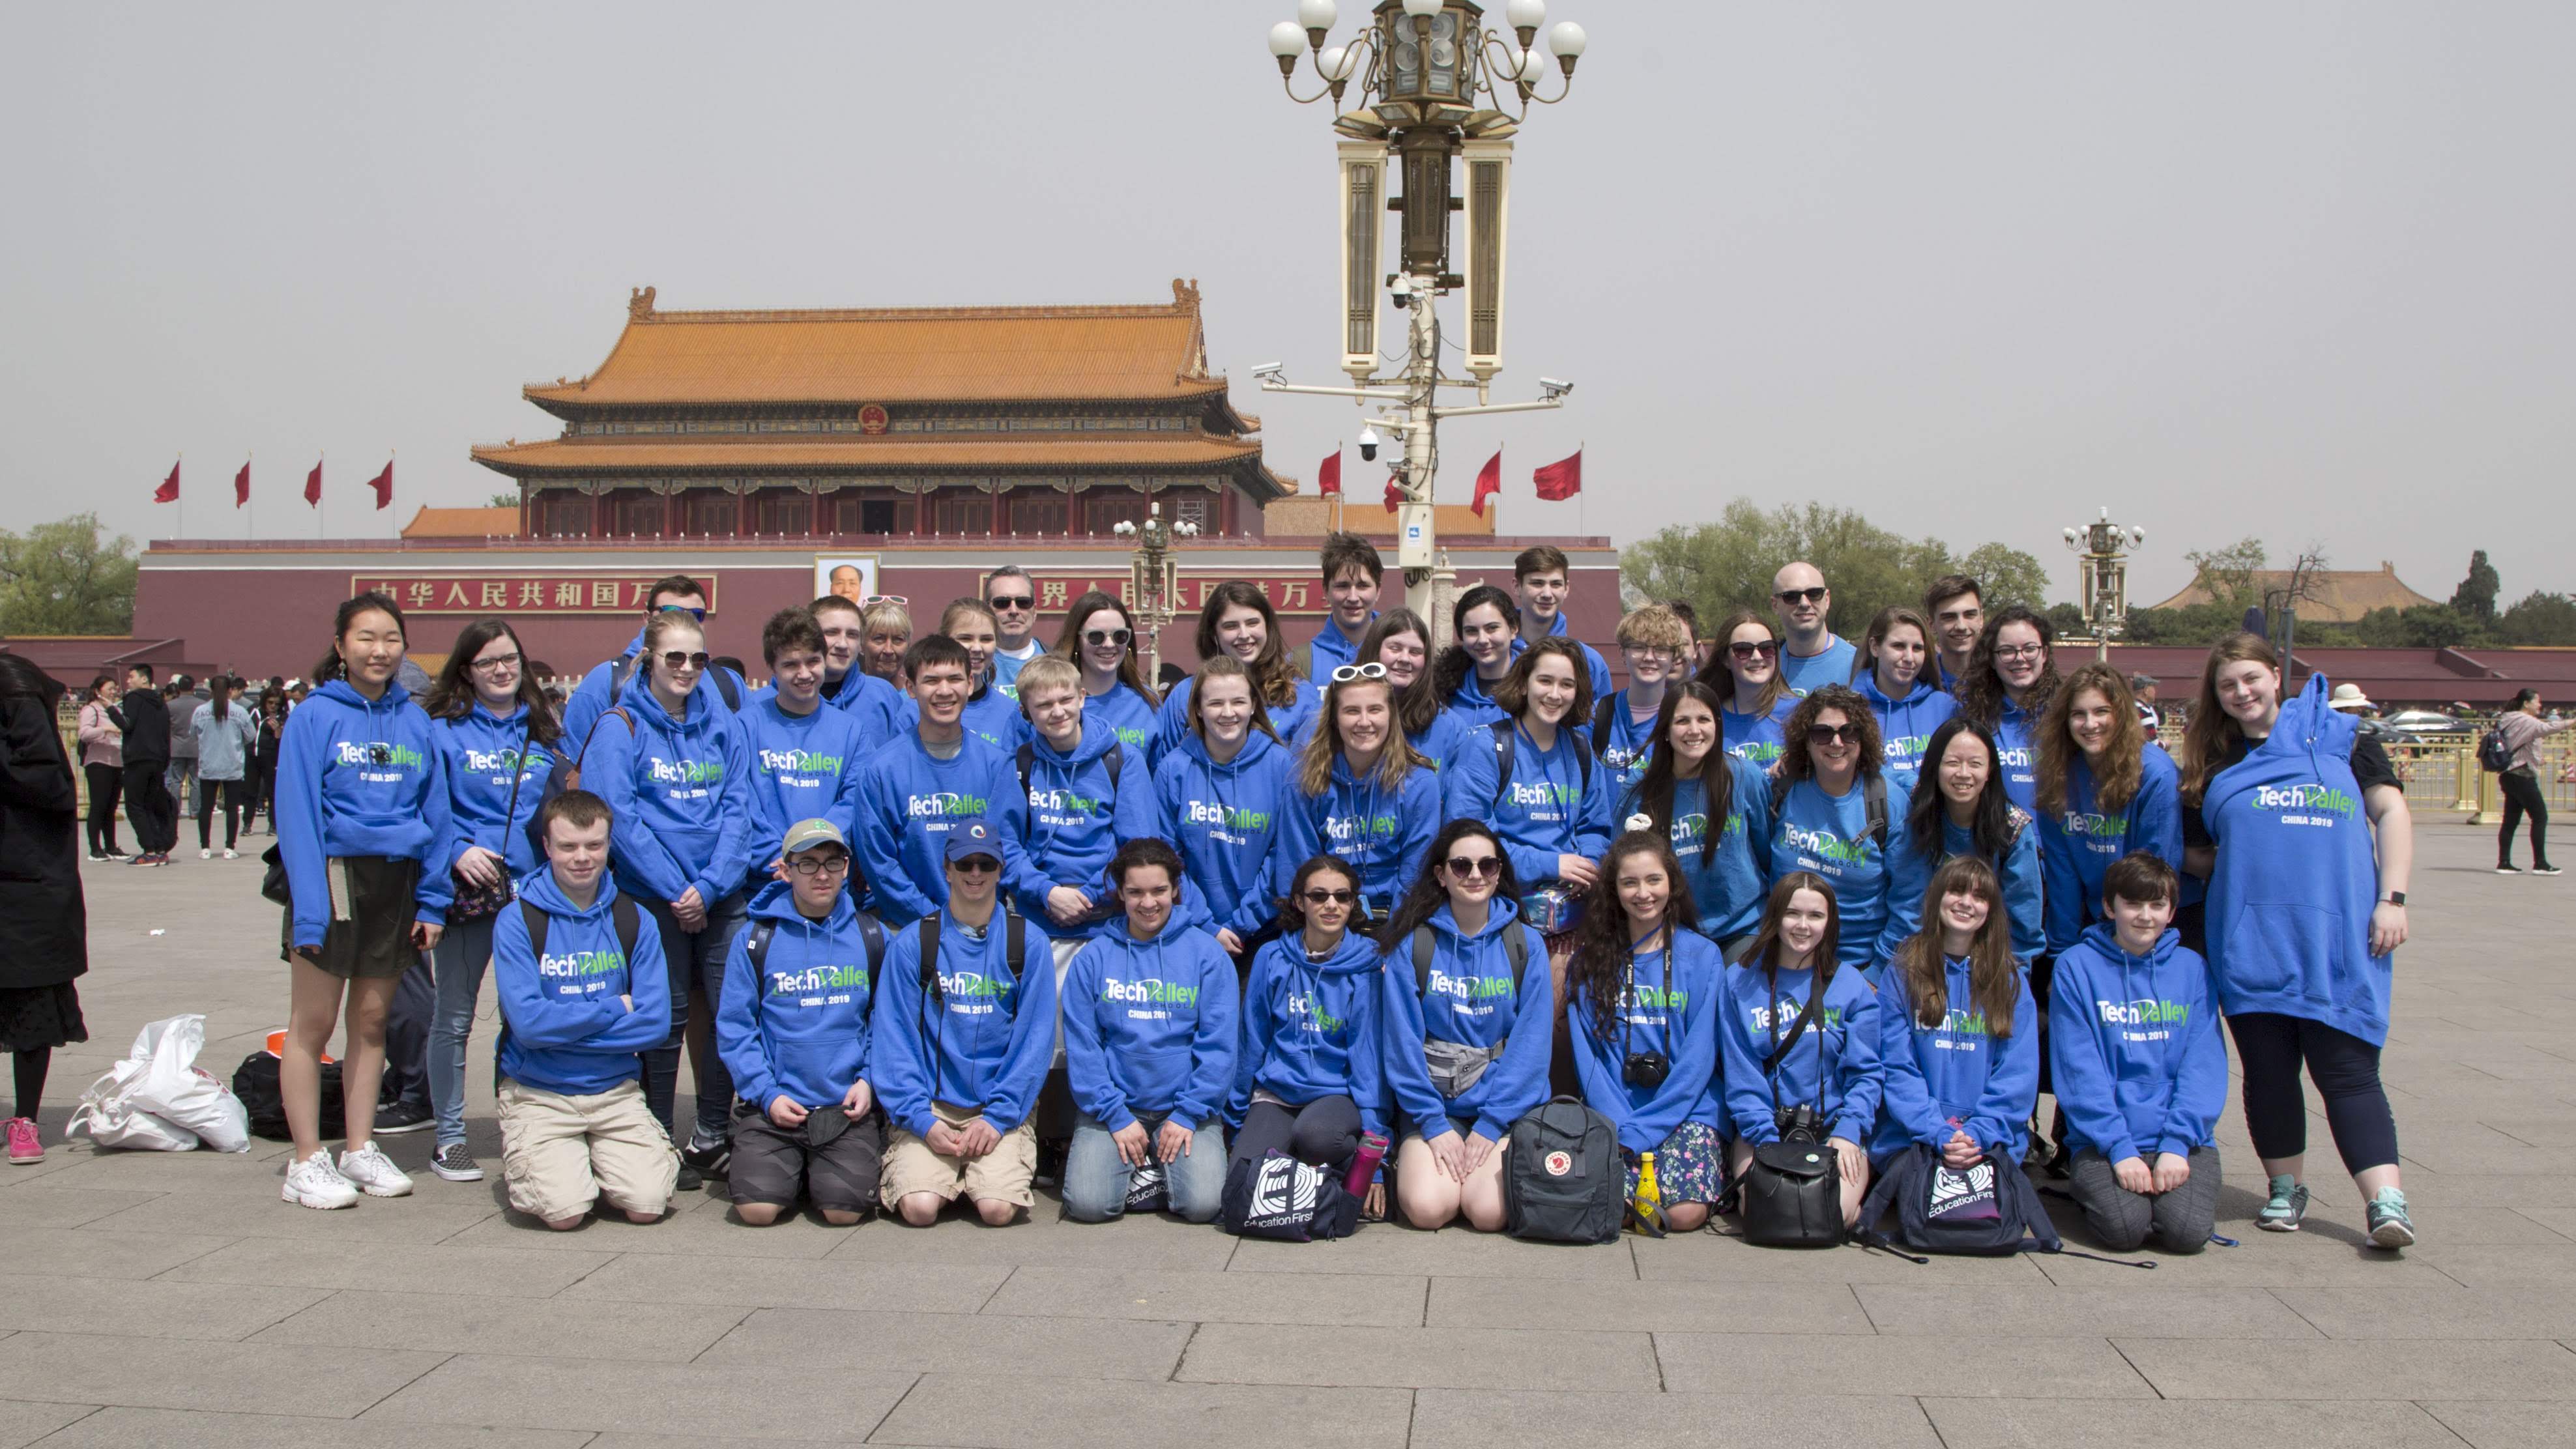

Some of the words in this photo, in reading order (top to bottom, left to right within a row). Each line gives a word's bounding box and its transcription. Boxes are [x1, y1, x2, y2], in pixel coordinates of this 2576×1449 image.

[800, 779, 820, 787] 2019
[2257, 785, 2356, 821] TechValley
[2305, 808, 2347, 819] SCHOOL
[1065, 817, 1084, 825] 2019
[2281, 815, 2309, 825] CHINA
[2310, 817, 2333, 827] 2019
[926, 823, 949, 831] CHINA
[1797, 857, 1821, 870] CHINA
[1822, 864, 1842, 876] 2019
[586, 981, 606, 992] 2019
[1106, 978, 1198, 1009] TechValley
[828, 995, 850, 1004] 2019
[972, 1005, 993, 1014] 2019
[1128, 1009, 1153, 1019] CHINA
[2096, 999, 2190, 1027] TechValley
[1649, 1016, 1666, 1025] 2019
[1935, 1039, 1953, 1049] CHIN
[1956, 1042, 1975, 1051] 2019
[1127, 1184, 1168, 1205] Educatio
[1929, 1193, 1977, 1218] Education
[1976, 1191, 1994, 1201] Firs
[1292, 1211, 1314, 1224] First
